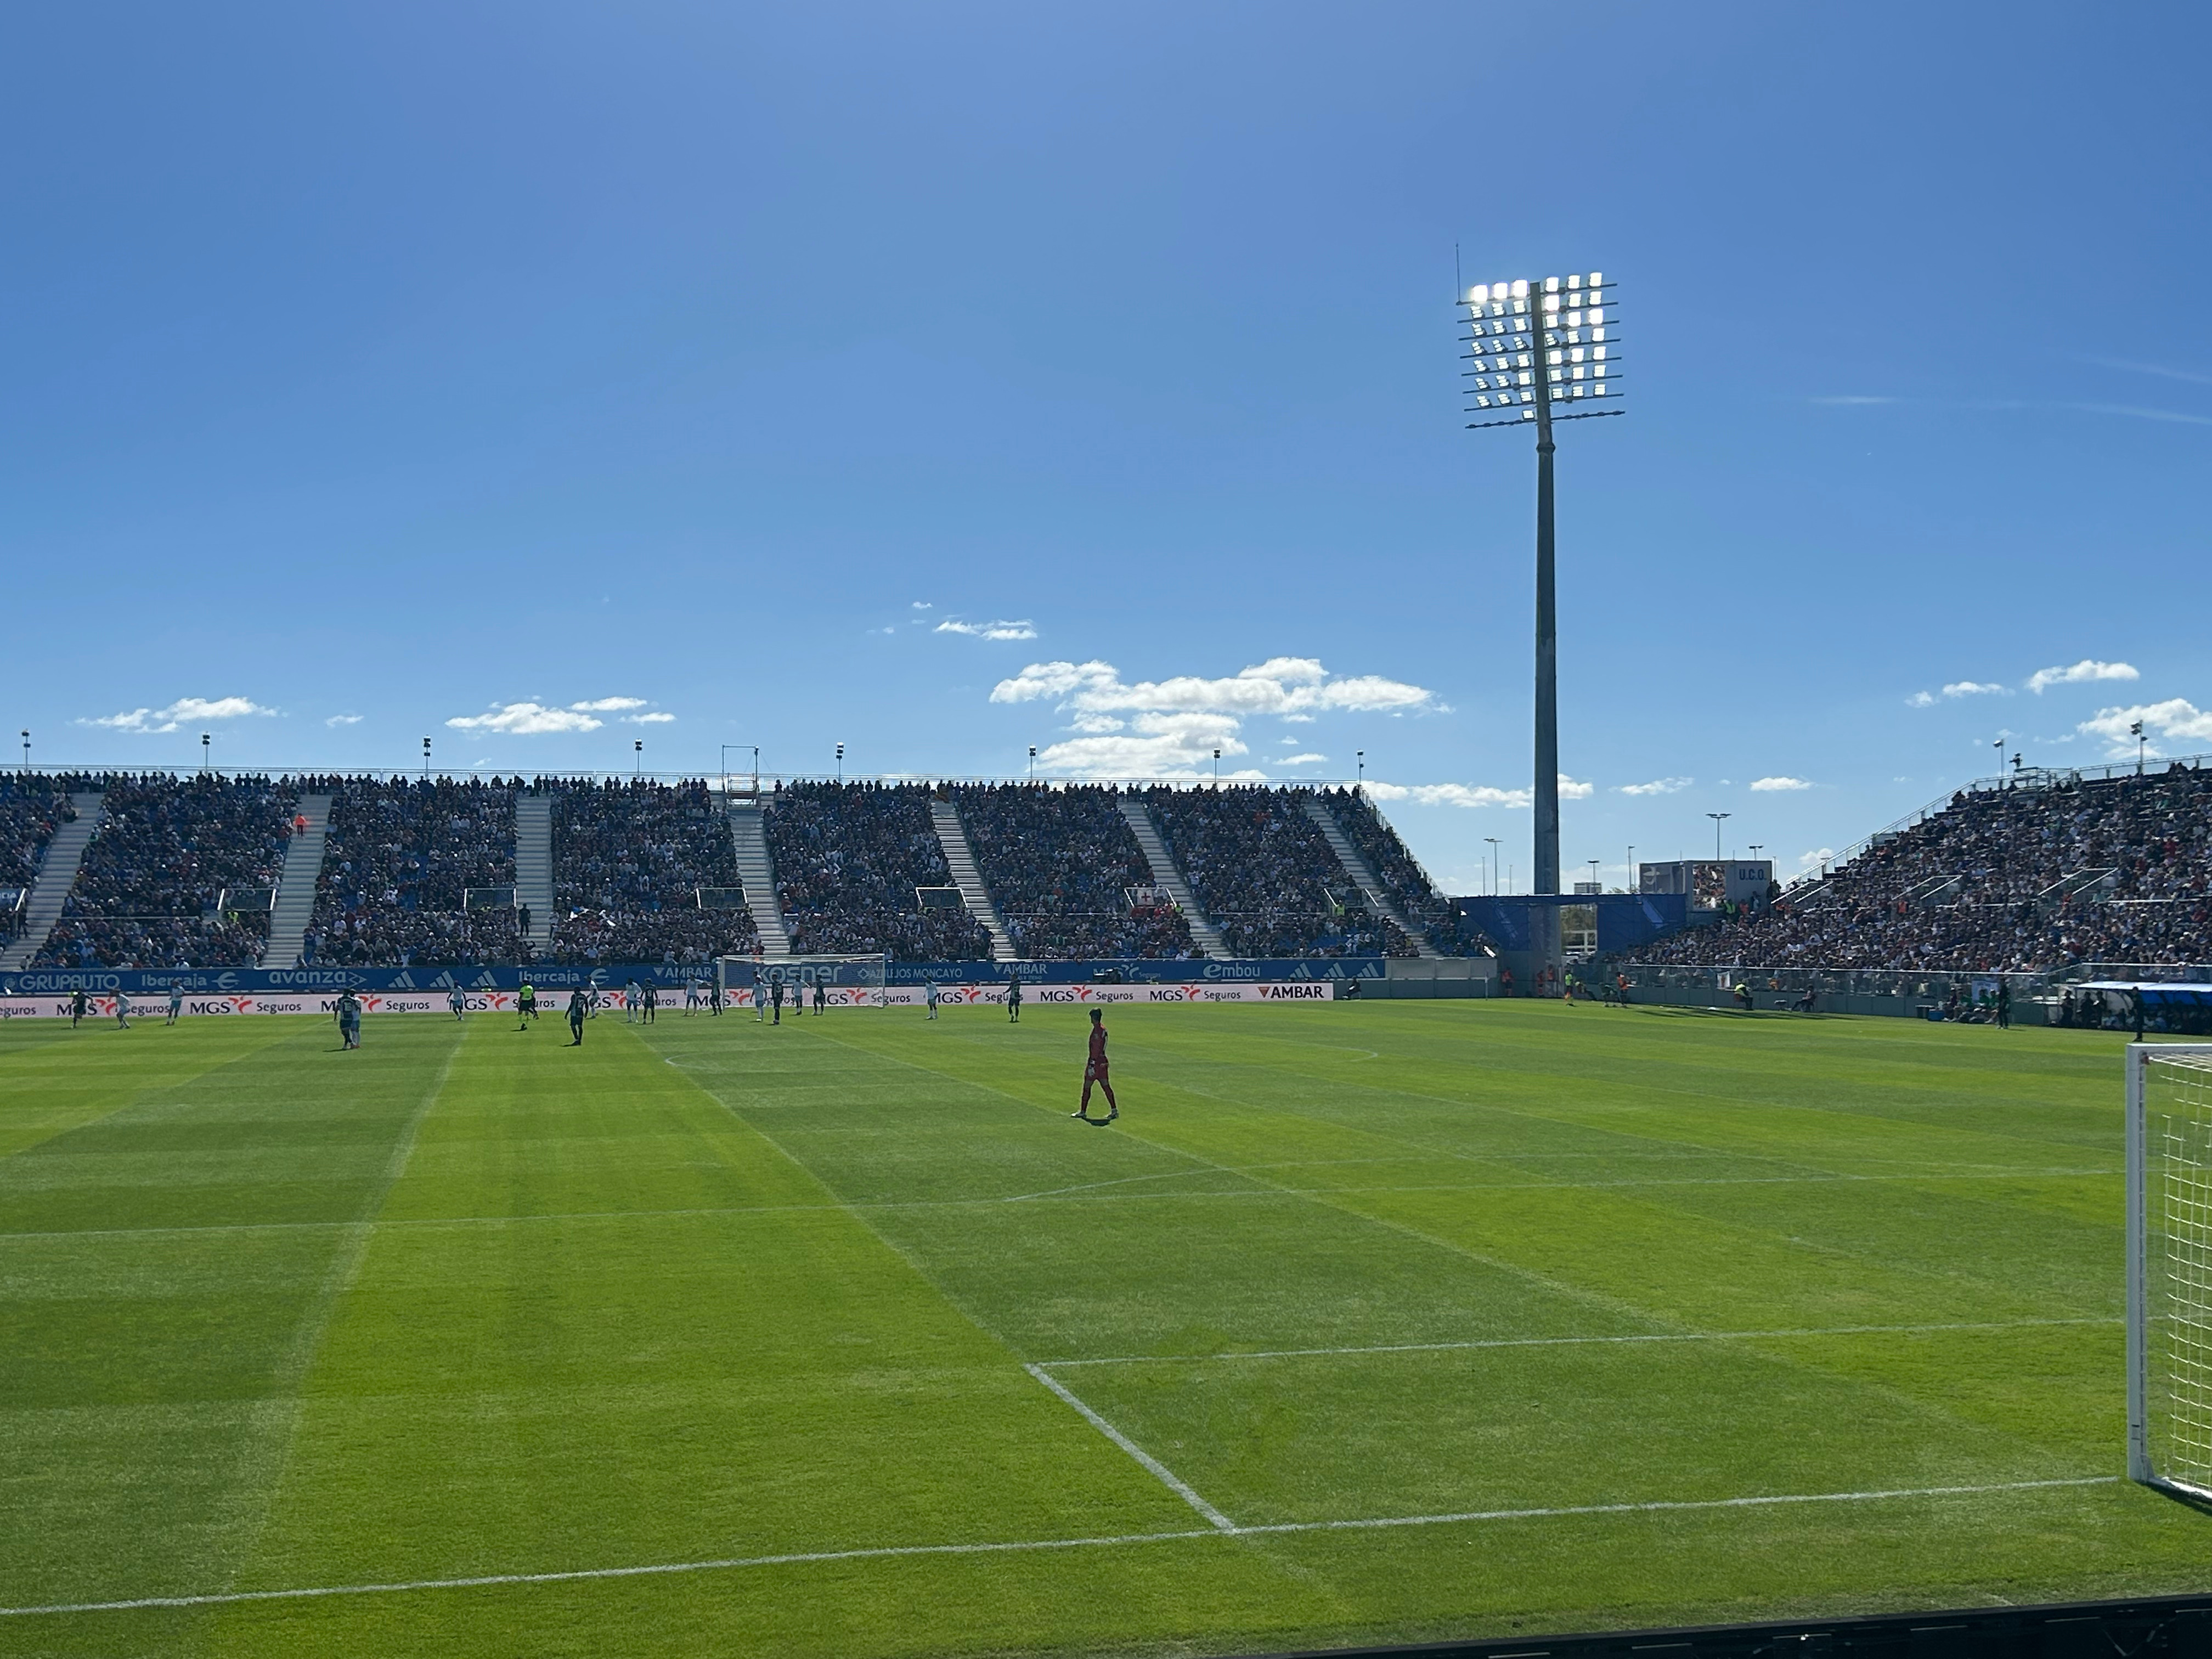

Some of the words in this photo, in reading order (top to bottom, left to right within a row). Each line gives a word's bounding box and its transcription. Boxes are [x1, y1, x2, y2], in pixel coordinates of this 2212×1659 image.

[1739, 868, 1766, 881] U.C.O.
[664, 967, 713, 978] AMBAR
[868, 968, 911, 978] AZLEJOS
[912, 967, 963, 978] MONCAYO
[1002, 963, 1048, 974] AMBAR
[1203, 962, 1261, 978] embou
[19, 974, 120, 990] GRUPAUTO
[269, 970, 347, 984] avanza
[518, 969, 585, 984] Ibercaja
[985, 992, 1024, 1003] Segus
[1040, 991, 1074, 1002] MGS
[1096, 991, 1133, 1003] Seguros
[1150, 990, 1183, 1001] MGS
[1204, 990, 1241, 1002] Seguros
[1270, 986, 1324, 998] AMBAR
[696, 995, 731, 1007] MS
[871, 994, 911, 1005] Seguros
[57, 1003, 98, 1015] MS
[126, 1006, 171, 1016] eguros
[190, 1001, 230, 1014] MGS
[256, 1002, 302, 1014] Seguros
[386, 1000, 430, 1013] Seguros
